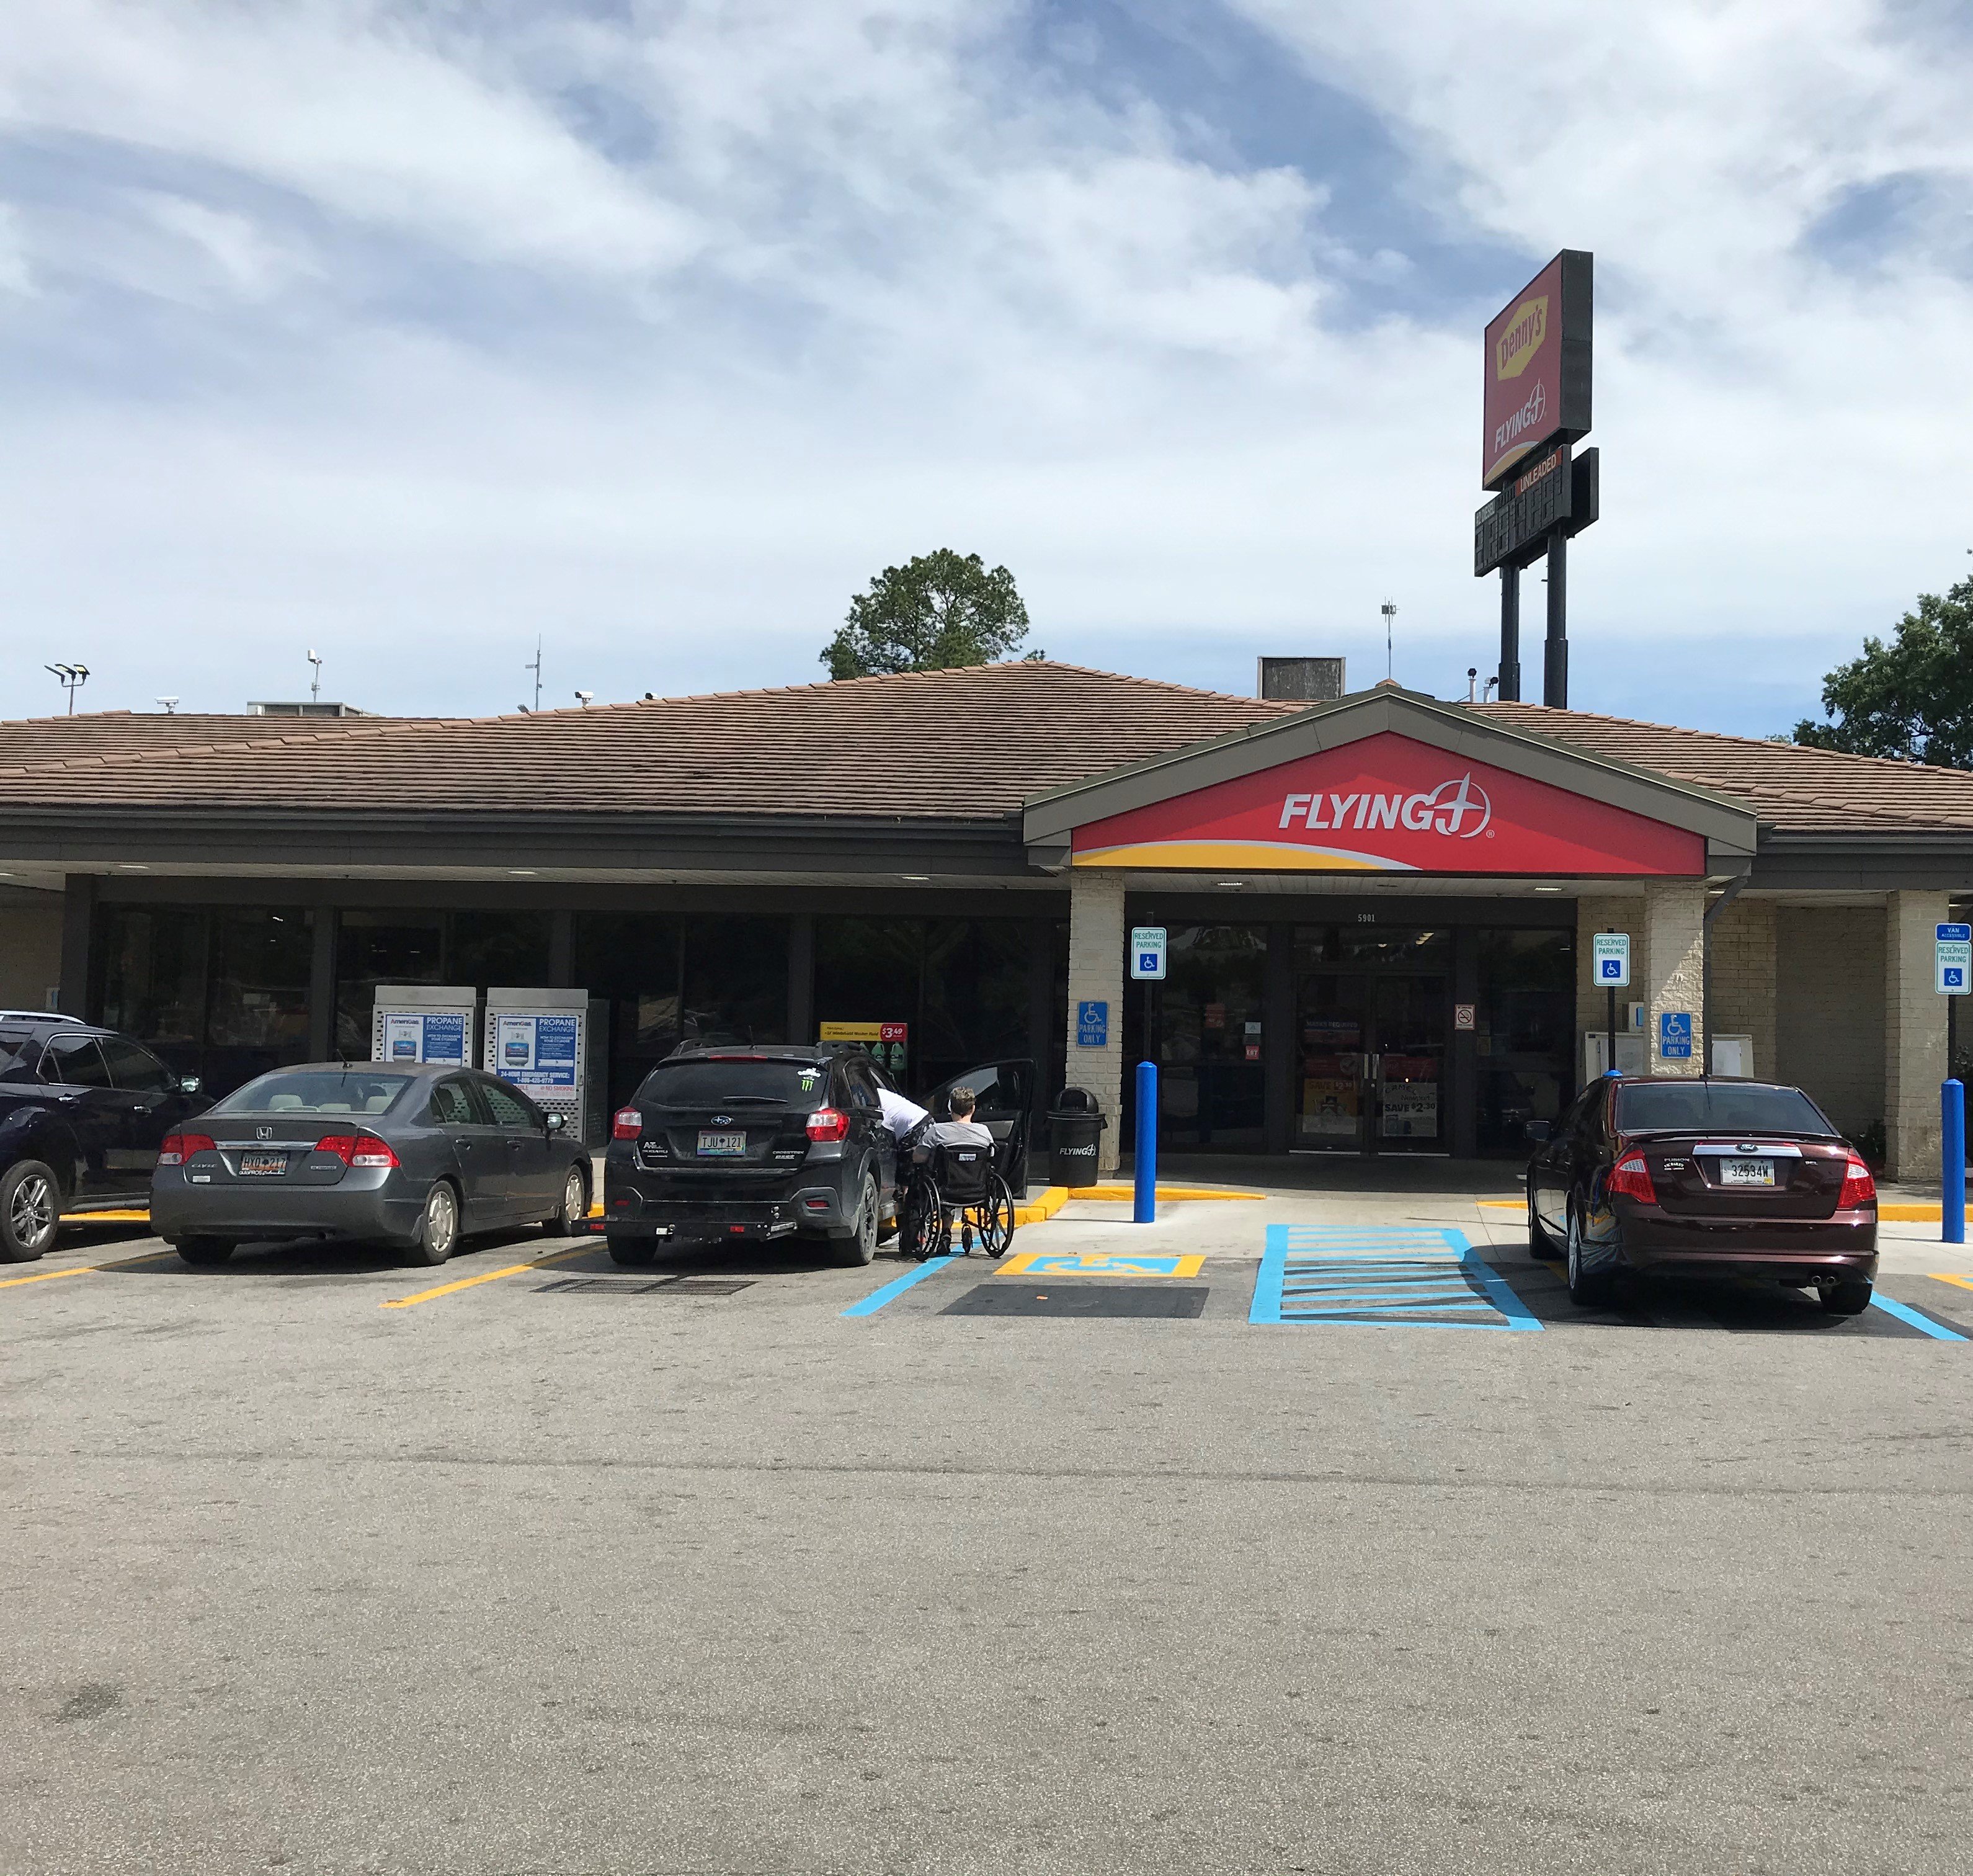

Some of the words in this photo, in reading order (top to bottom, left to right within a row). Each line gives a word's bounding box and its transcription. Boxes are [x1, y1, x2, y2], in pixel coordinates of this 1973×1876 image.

[1501, 305, 1543, 370] Denny's
[1520, 453, 1557, 493] UNLEADED
[1358, 913, 1375, 922] 5901
[427, 1017, 463, 1025] PROPANE
[1079, 1024, 1106, 1034] PARKING
[1083, 1034, 1100, 1043] ONLY
[1662, 1036, 1690, 1045] PARKING
[1667, 1046, 1685, 1055] ONLY
[1309, 1081, 1331, 1090] SAVE
[1385, 1084, 1416, 1096] CAMEL
[1384, 1104, 1410, 1112] SAVE
[703, 1137, 718, 1147] TJU
[726, 1137, 741, 1147] 121
[270, 1158, 286, 1168] 217
